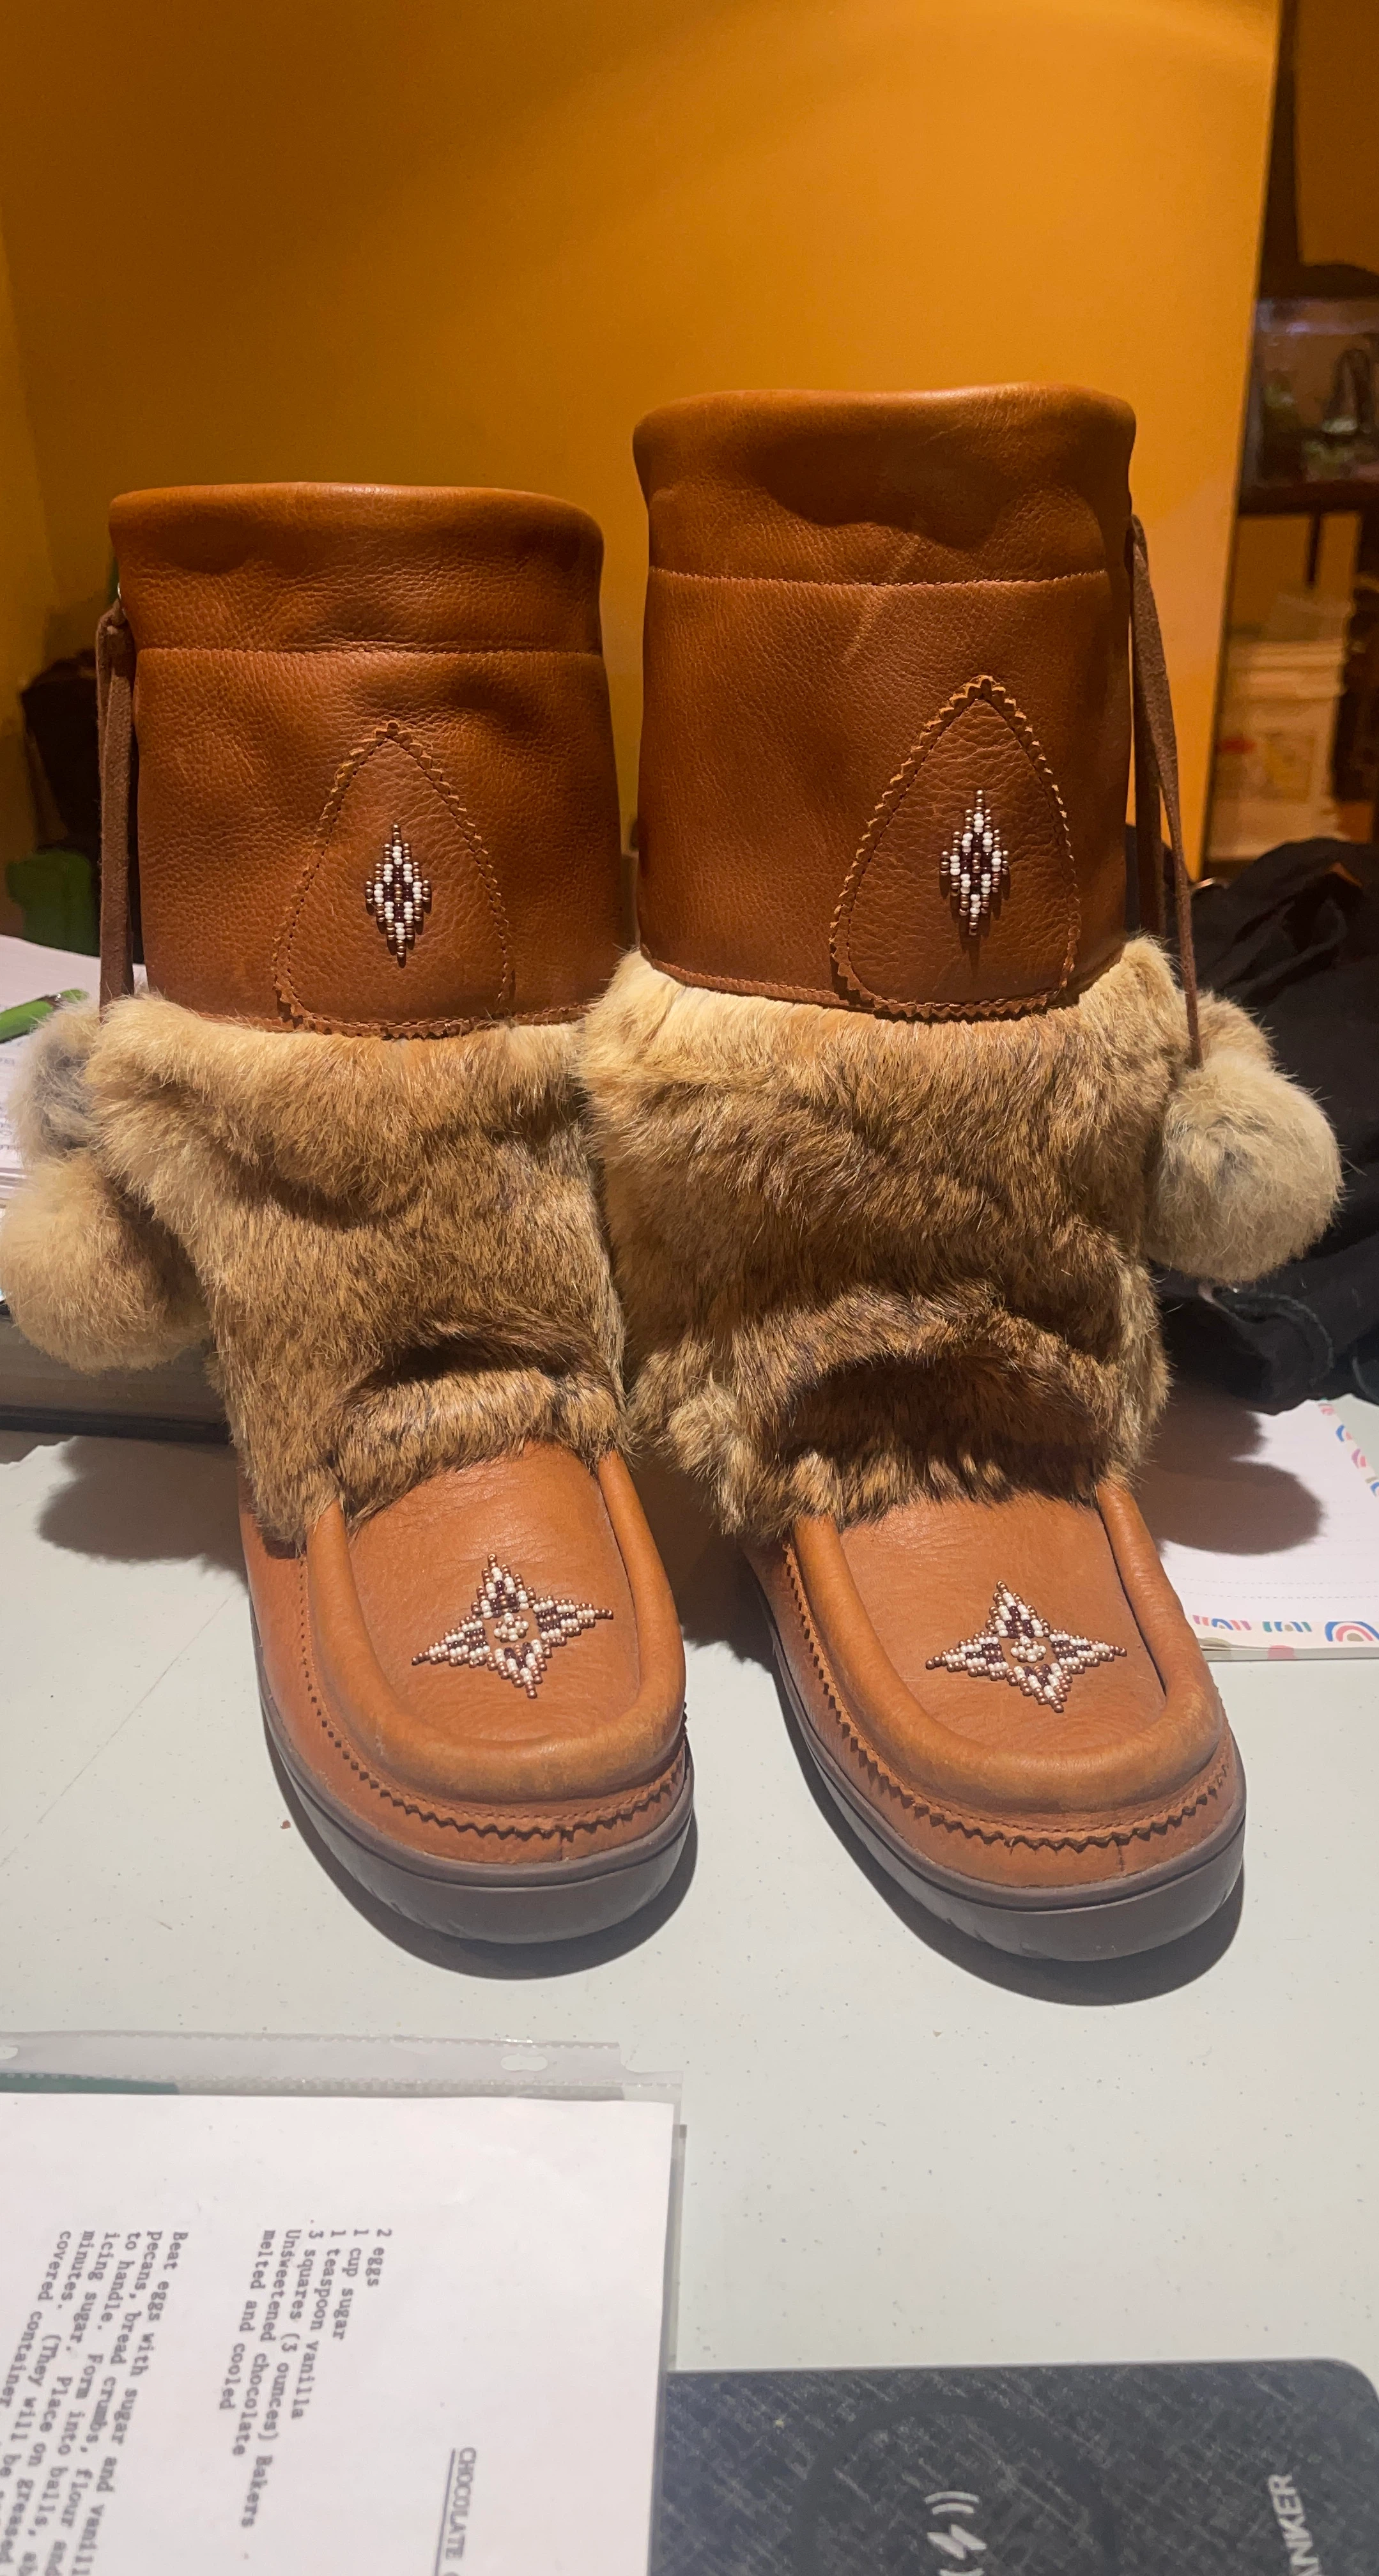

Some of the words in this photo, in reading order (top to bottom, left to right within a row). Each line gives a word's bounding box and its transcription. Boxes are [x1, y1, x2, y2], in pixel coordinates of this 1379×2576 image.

[88, 2232, 121, 2281] icing
[125, 2232, 141, 2251] to
[164, 2232, 189, 2270] Beat
[250, 2230, 276, 2290] melted
[308, 2230, 324, 2239] 3
[330, 2229, 346, 2237] 1
[353, 2228, 369, 2237] 1
[376, 2228, 392, 2237] 2
[37, 2230, 72, 2301] covered
[58, 2230, 95, 2310] minutes.
[129, 2230, 163, 2299] pecans,
[260, 2229, 302, 2342] Unsweetened
[289, 2248, 316, 2320] squares
[310, 2248, 341, 2331] teaspoon
[342, 2248, 362, 2277] cup
[365, 2247, 385, 2287] eggs
[66, 2291, 97, 2352] sugar.
[97, 2260, 135, 2331] handle.
[148, 2281, 169, 2321] eggs
[239, 2299, 258, 2332] and
[333, 2288, 354, 2340] sugar
[0, 2310, 43, 2408] container
[27, 2333, 62, 2386] (They
[110, 2310, 142, 2365] bread
[130, 2332, 155, 2377] with
[281, 2333, 300, 2352] (3
[40, 2375, 73, 2432] Place
[75, 2353, 104, 2399] Form
[219, 2343, 245, 2410] cooled
[257, 2363, 289, 2440] ounces)
[291, 2340, 319, 2419] vanilla
[11, 2396, 37, 2441] will
[81, 2376, 116, 2453] crumbs,
[111, 2388, 138, 2446] sugar
[233, 2353, 270, 2455] chocolate
[28, 2442, 47, 2466] on
[58, 2411, 86, 2455] into
[0, 2453, 22, 2477] be
[96, 2457, 118, 2492] and
[241, 2455, 273, 2527] Bakers
[28, 2466, 69, 2536] balls,
[61, 2468, 93, 2528] flour
[445, 2447, 477, 2560] CHOCOLATE
